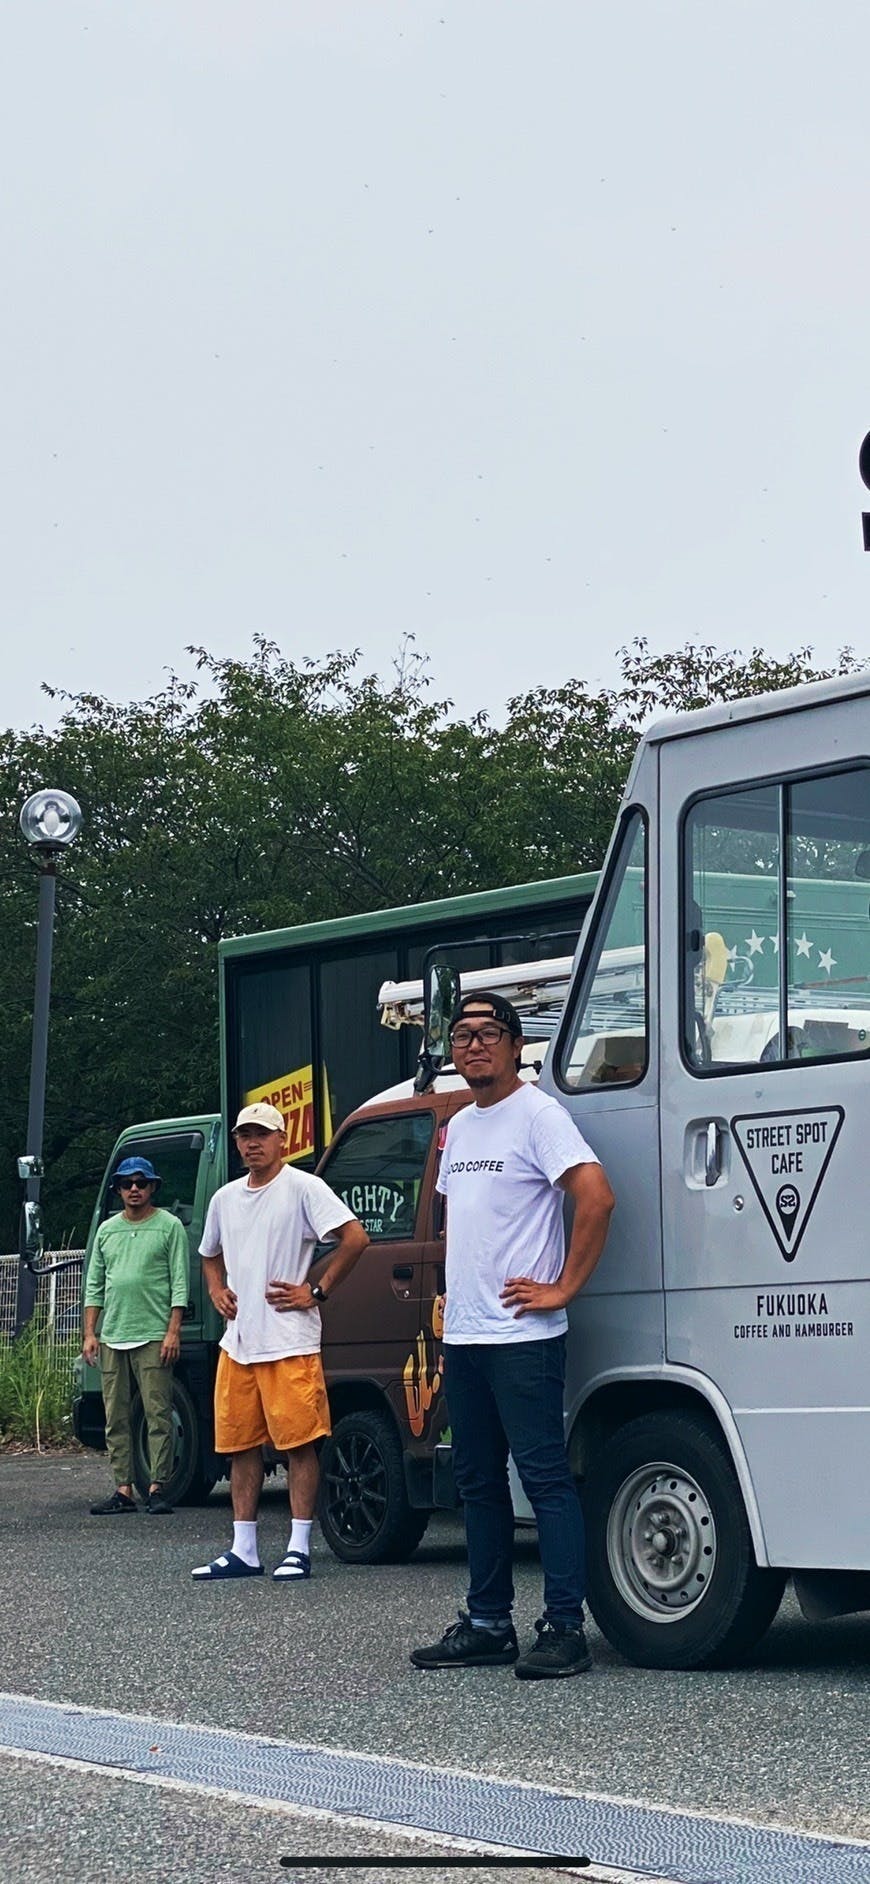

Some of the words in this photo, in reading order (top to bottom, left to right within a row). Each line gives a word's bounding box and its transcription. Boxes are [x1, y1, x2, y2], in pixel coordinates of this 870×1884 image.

[747, 1125, 792, 1149] STREET
[796, 1122, 828, 1144] SPOT
[466, 1160, 504, 1172] COFFEE
[771, 1151, 804, 1174] CAFE
[341, 1185, 404, 1222] IGHTY
[365, 1219, 383, 1232] STAR
[757, 1293, 828, 1317] FUKUOKA
[734, 1325, 768, 1338] COFFEE
[772, 1324, 791, 1337] AND
[795, 1322, 854, 1337] HAMBURGER
